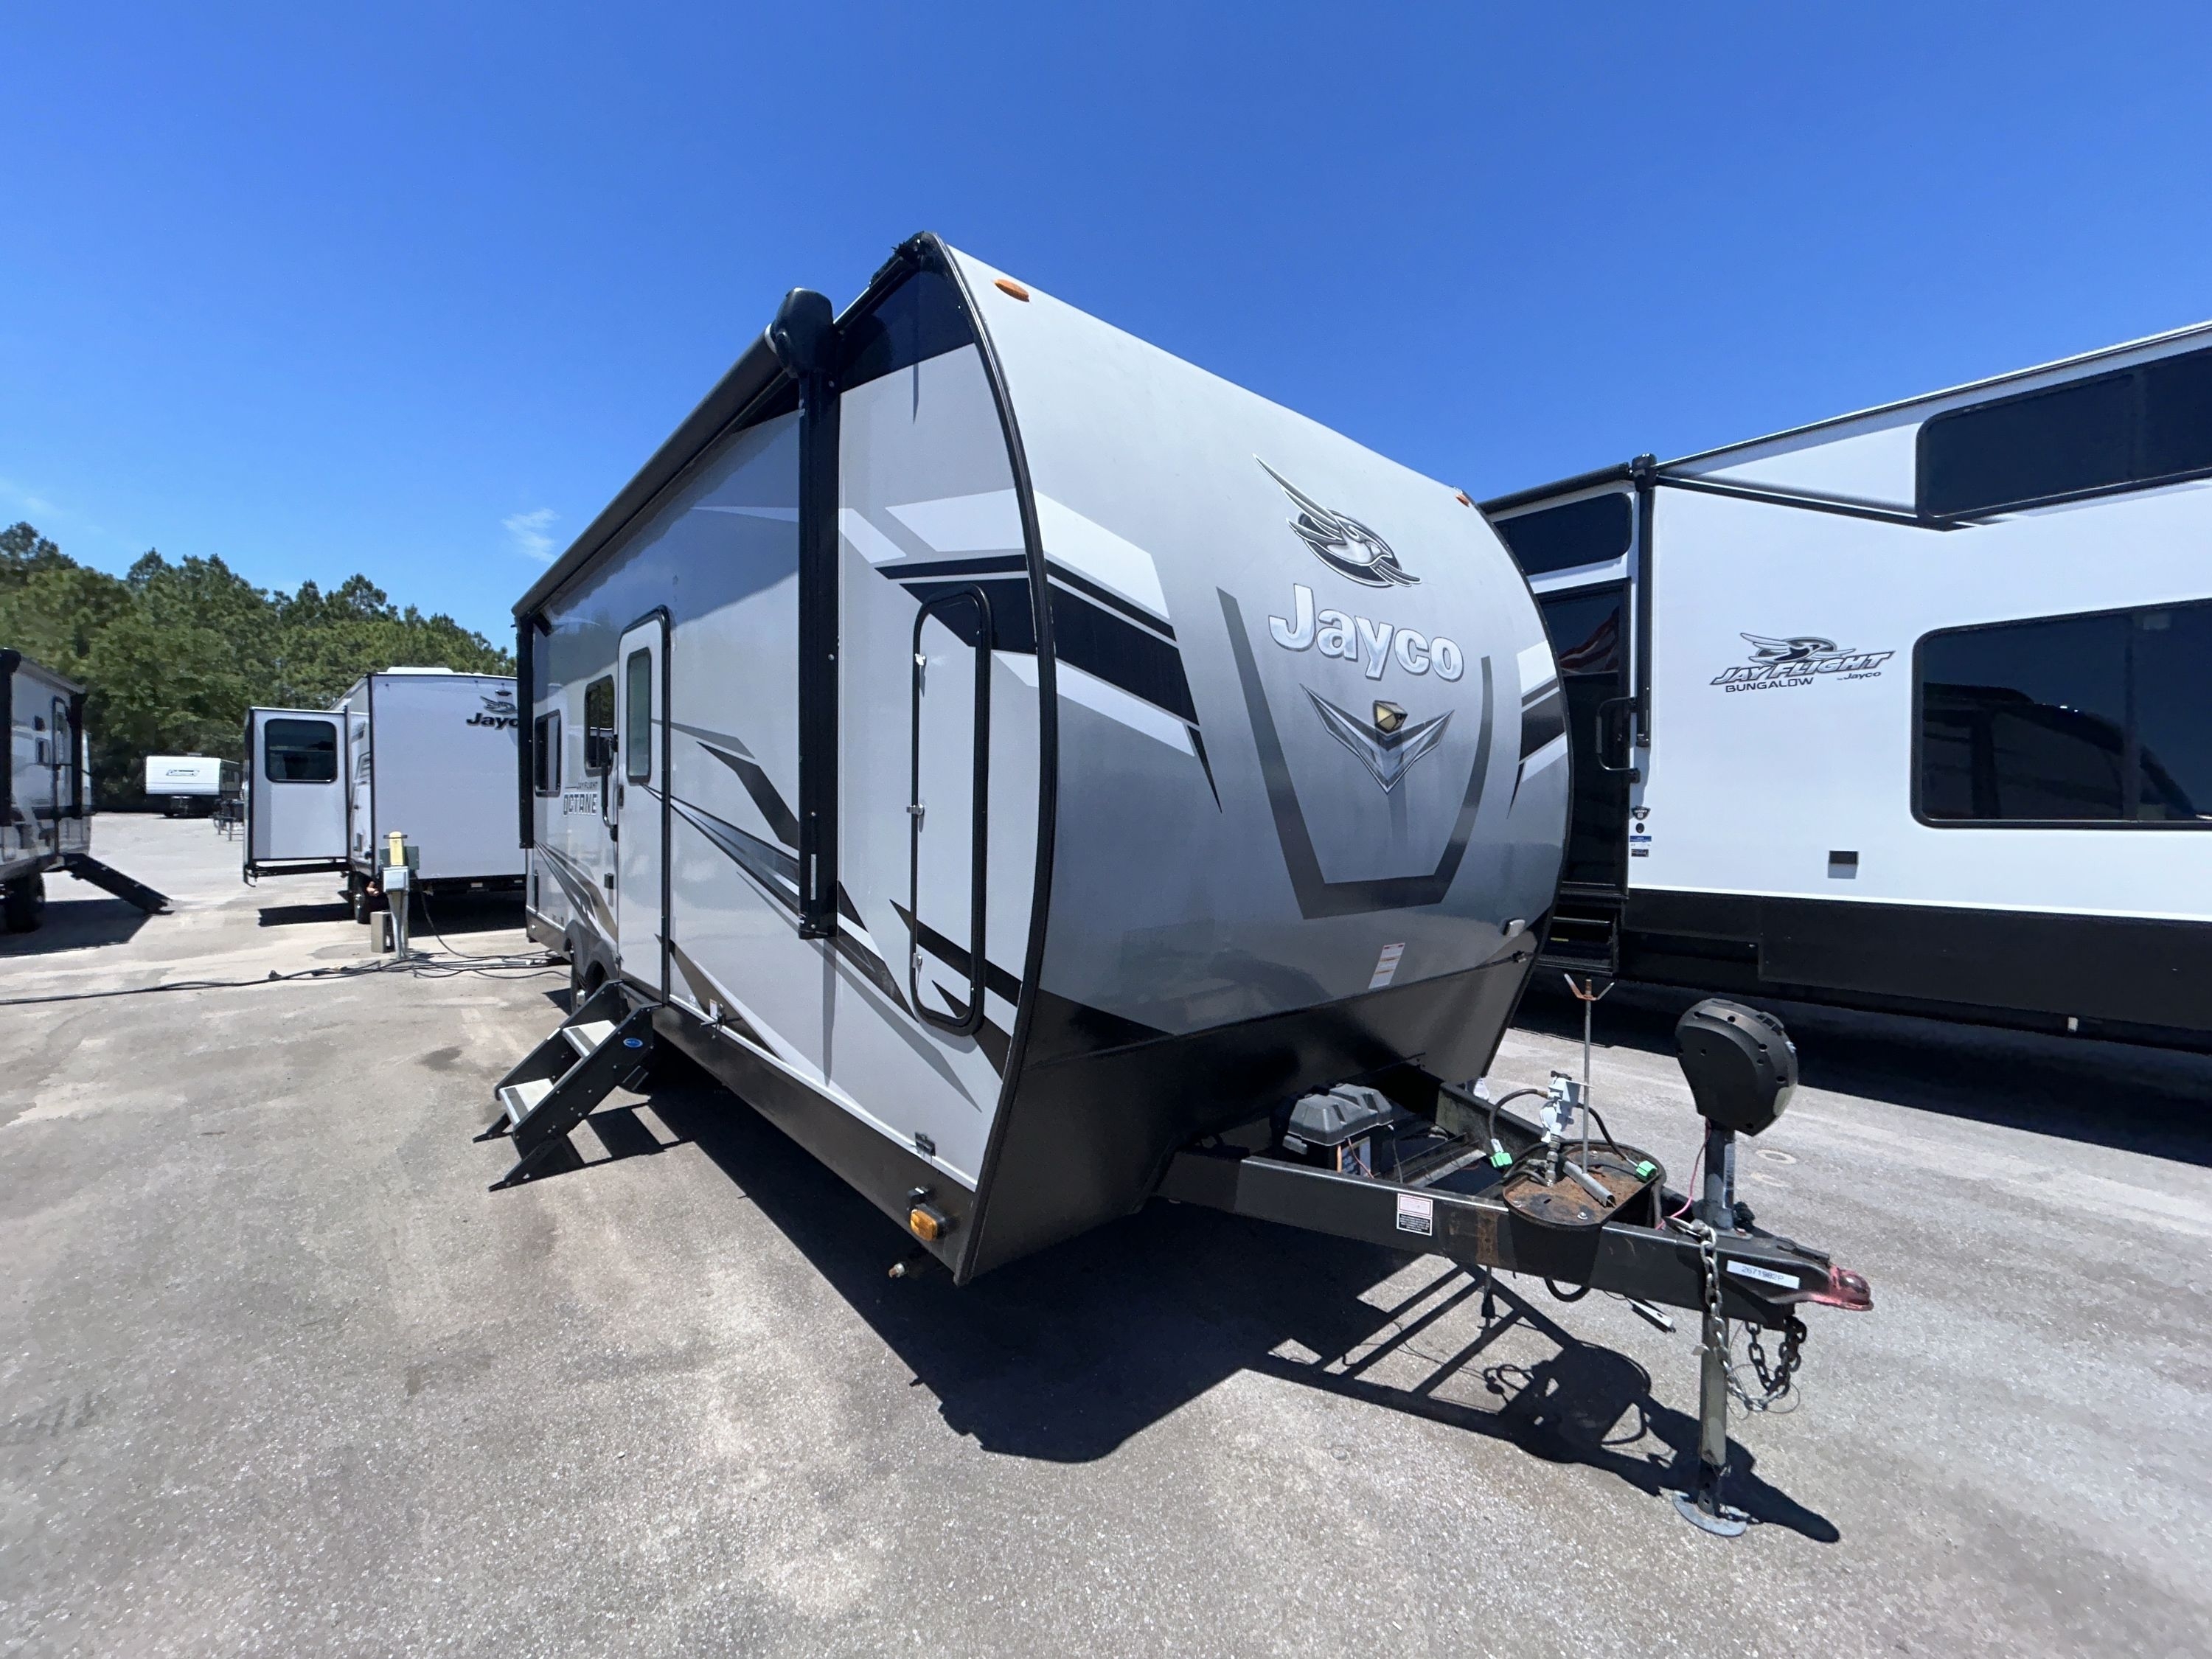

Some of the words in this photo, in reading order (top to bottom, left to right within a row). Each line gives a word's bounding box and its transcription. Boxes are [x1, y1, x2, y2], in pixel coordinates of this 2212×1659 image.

[1268, 582, 1464, 682] Jayco
[1710, 665, 1771, 685] JAY
[1768, 650, 1896, 679] FLIGHT
[1843, 672, 1882, 680] Jayco
[1725, 677, 1814, 692] BUNGALOW
[466, 712, 519, 730] Jayc
[563, 792, 597, 815] OCTANE
